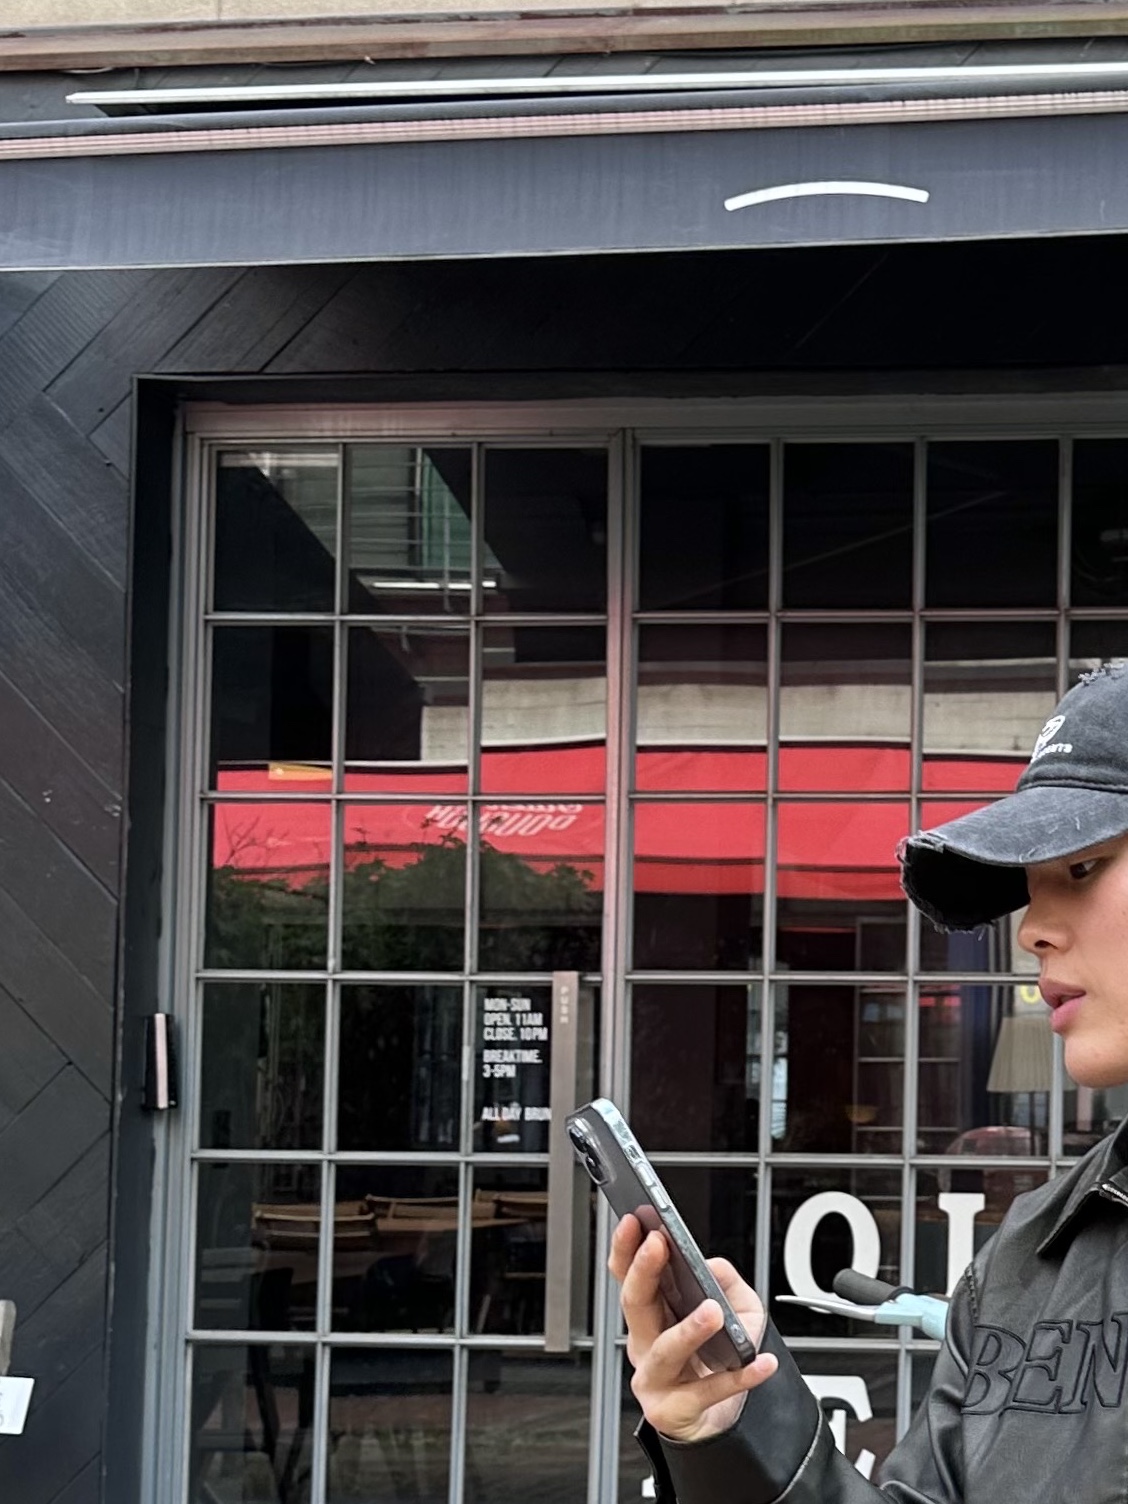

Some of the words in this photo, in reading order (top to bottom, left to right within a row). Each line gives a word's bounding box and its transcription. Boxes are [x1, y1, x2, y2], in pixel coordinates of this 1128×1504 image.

[515, 1012, 543, 1026] 11AM
[520, 1027, 548, 1041] 10PM
[482, 1064, 516, 1078] 3-5PM
